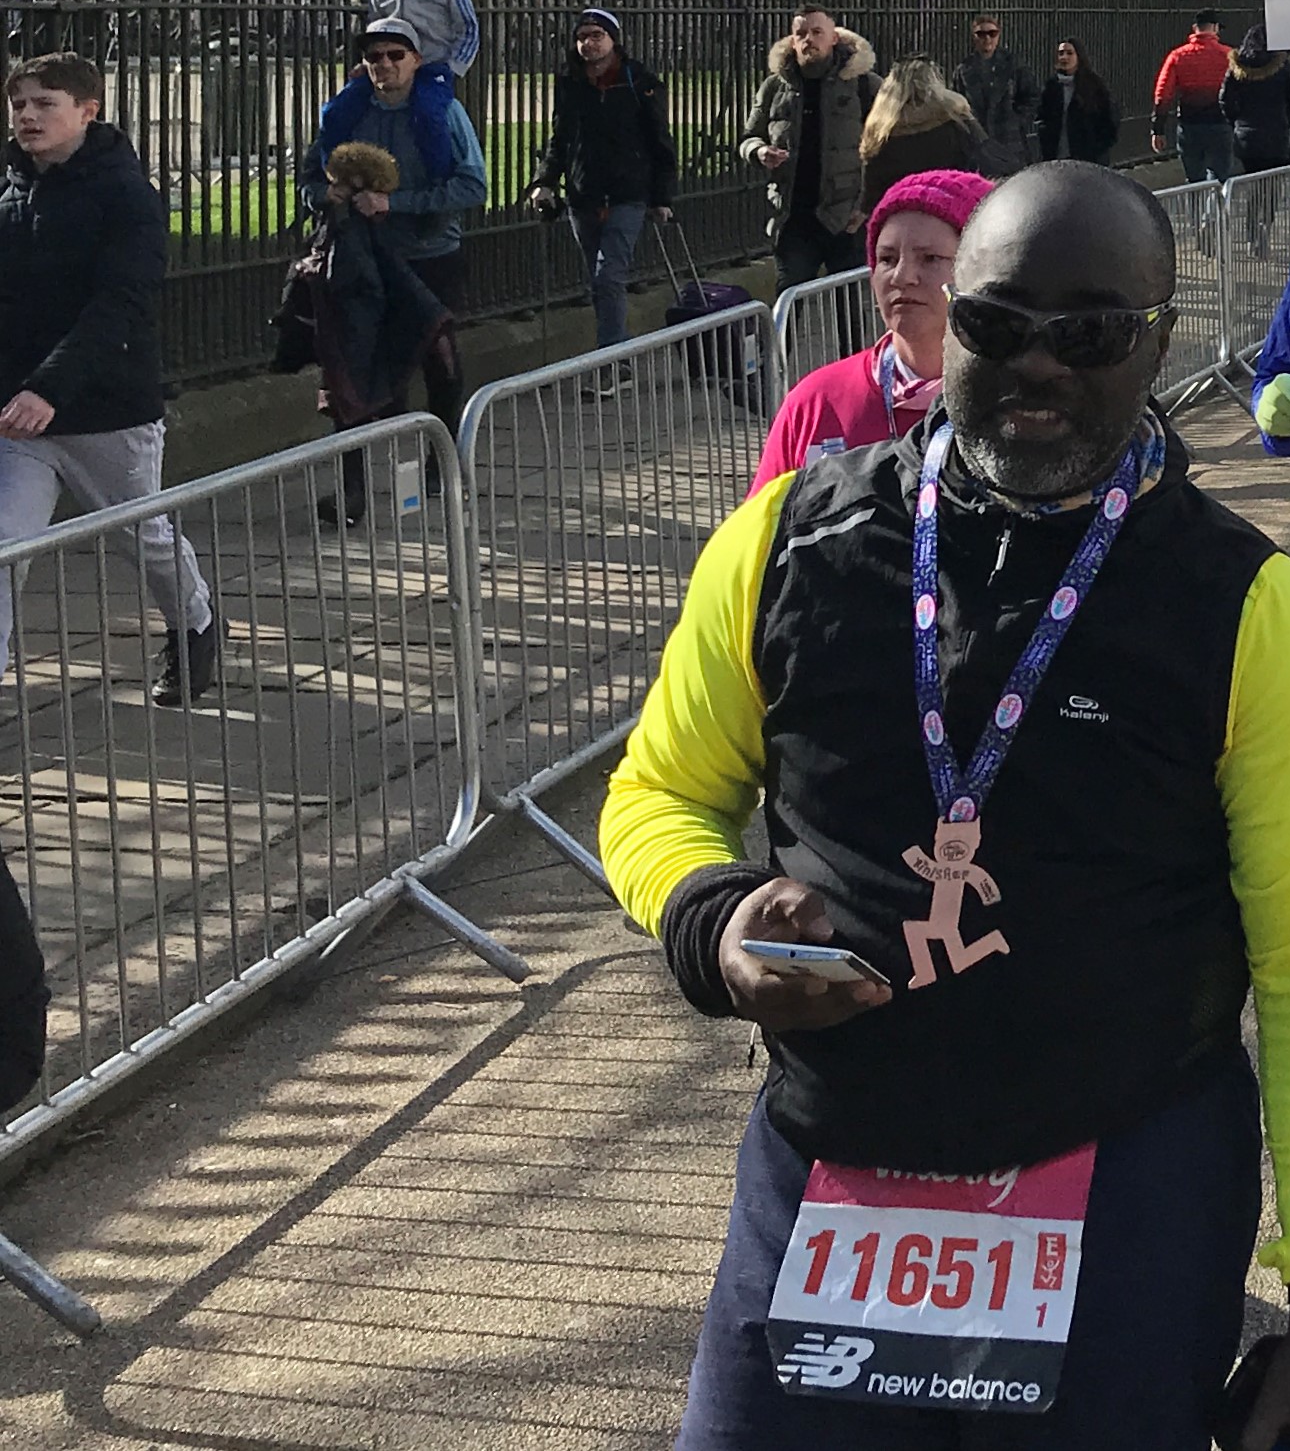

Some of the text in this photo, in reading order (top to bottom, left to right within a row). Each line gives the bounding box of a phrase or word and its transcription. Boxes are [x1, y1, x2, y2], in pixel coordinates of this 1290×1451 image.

[1059, 707, 1110, 724] Kalenji
[802, 1229, 1015, 1311] 11651
[1035, 1301, 1048, 1328] 1
[866, 1372, 926, 1398] new
[928, 1372, 1041, 1403] balance
